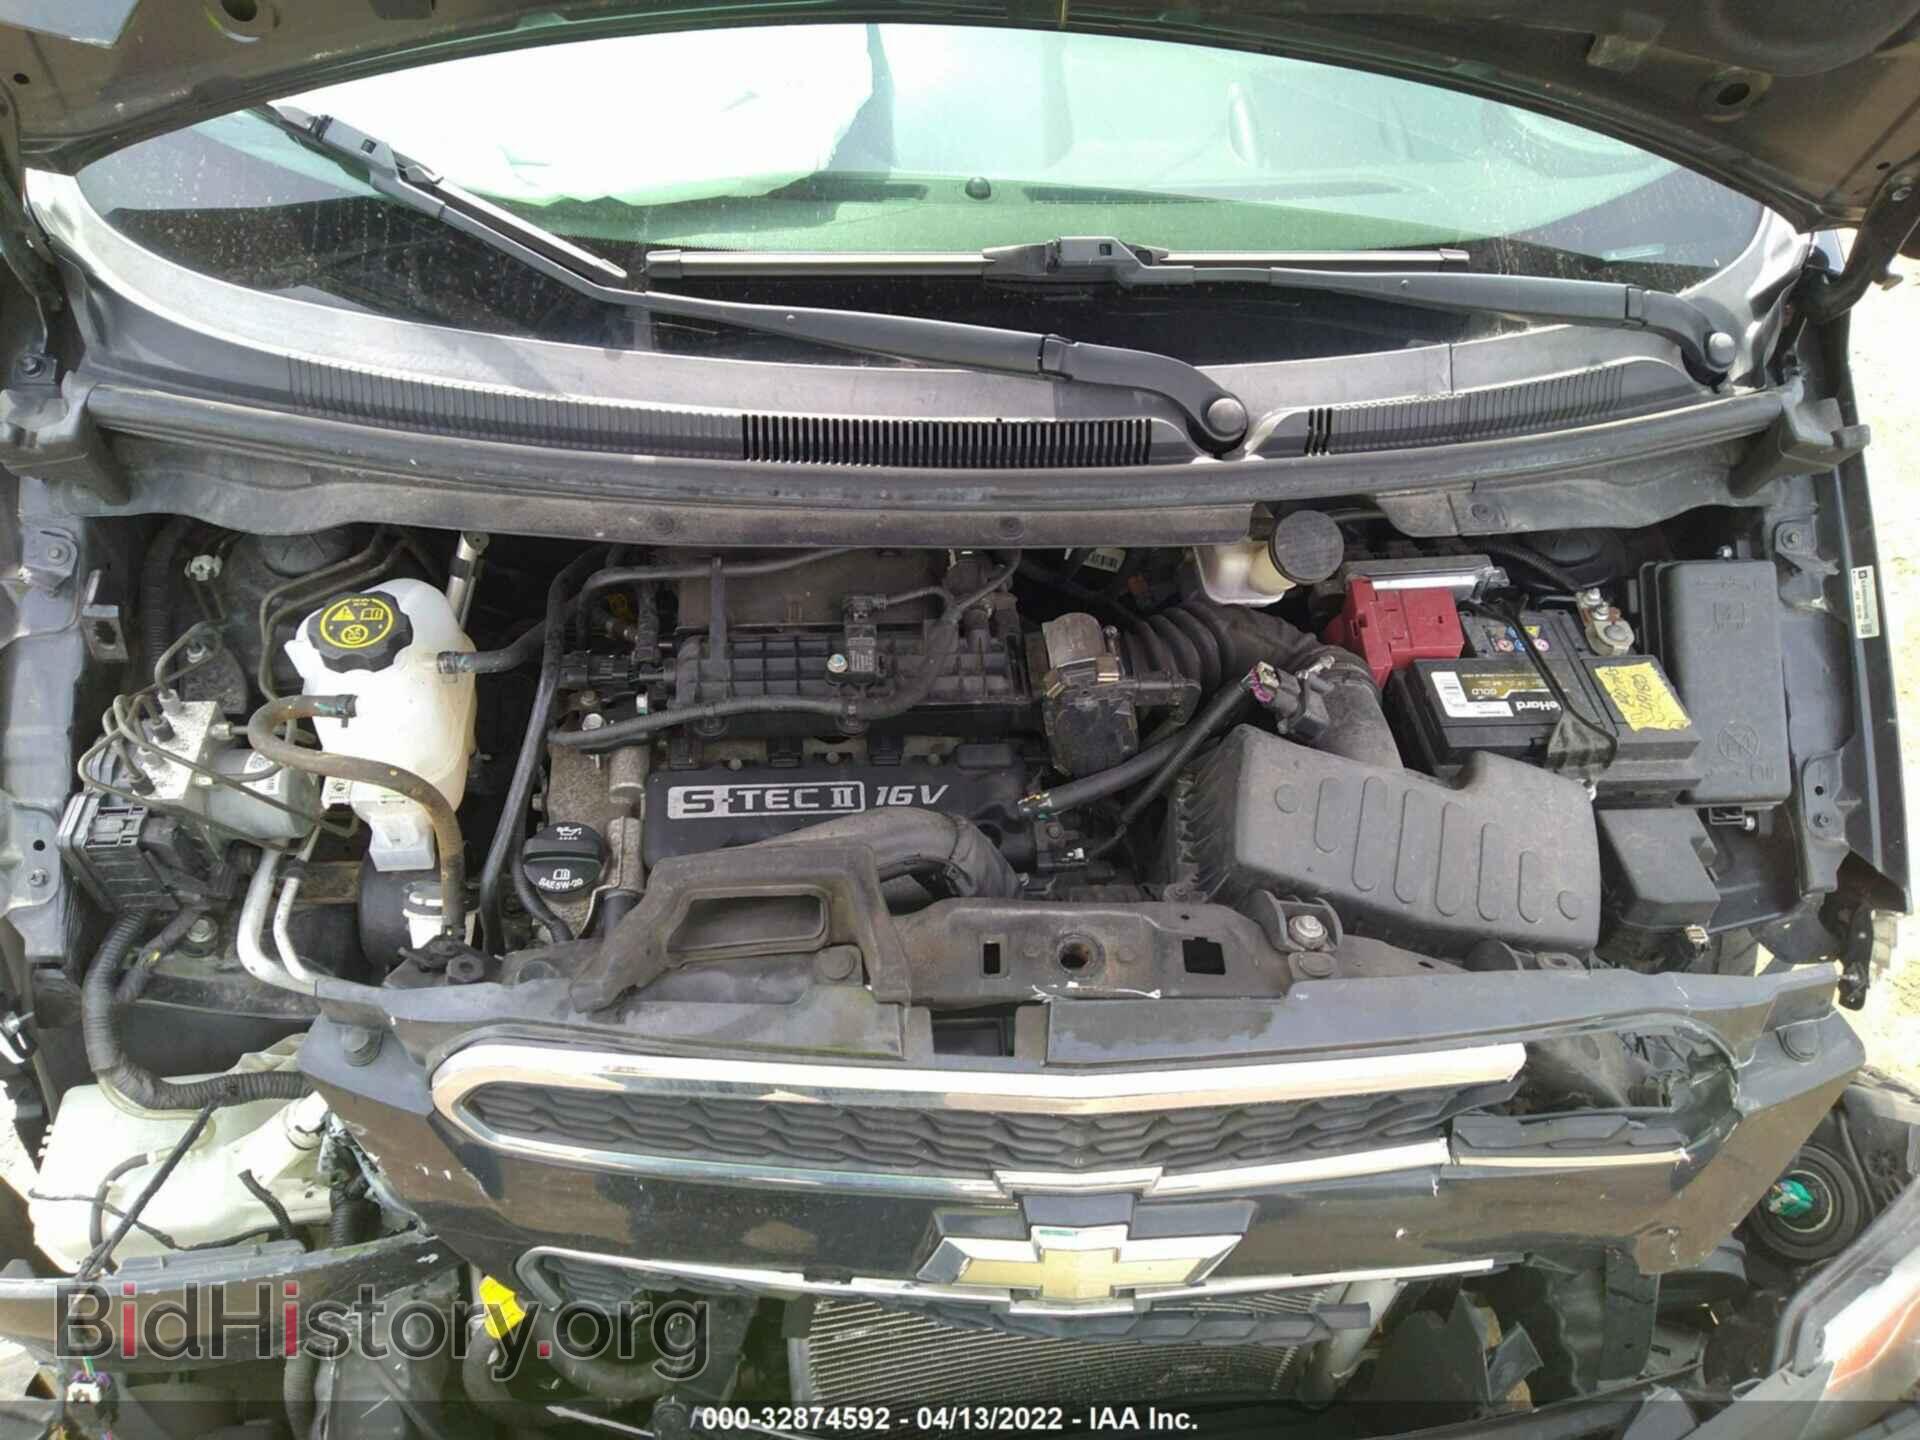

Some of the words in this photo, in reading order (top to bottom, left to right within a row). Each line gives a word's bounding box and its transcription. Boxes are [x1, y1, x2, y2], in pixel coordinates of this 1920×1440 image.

[1471, 687, 1498, 697] GOLD
[1515, 700, 1562, 712] eHard
[875, 784, 949, 806] 16V
